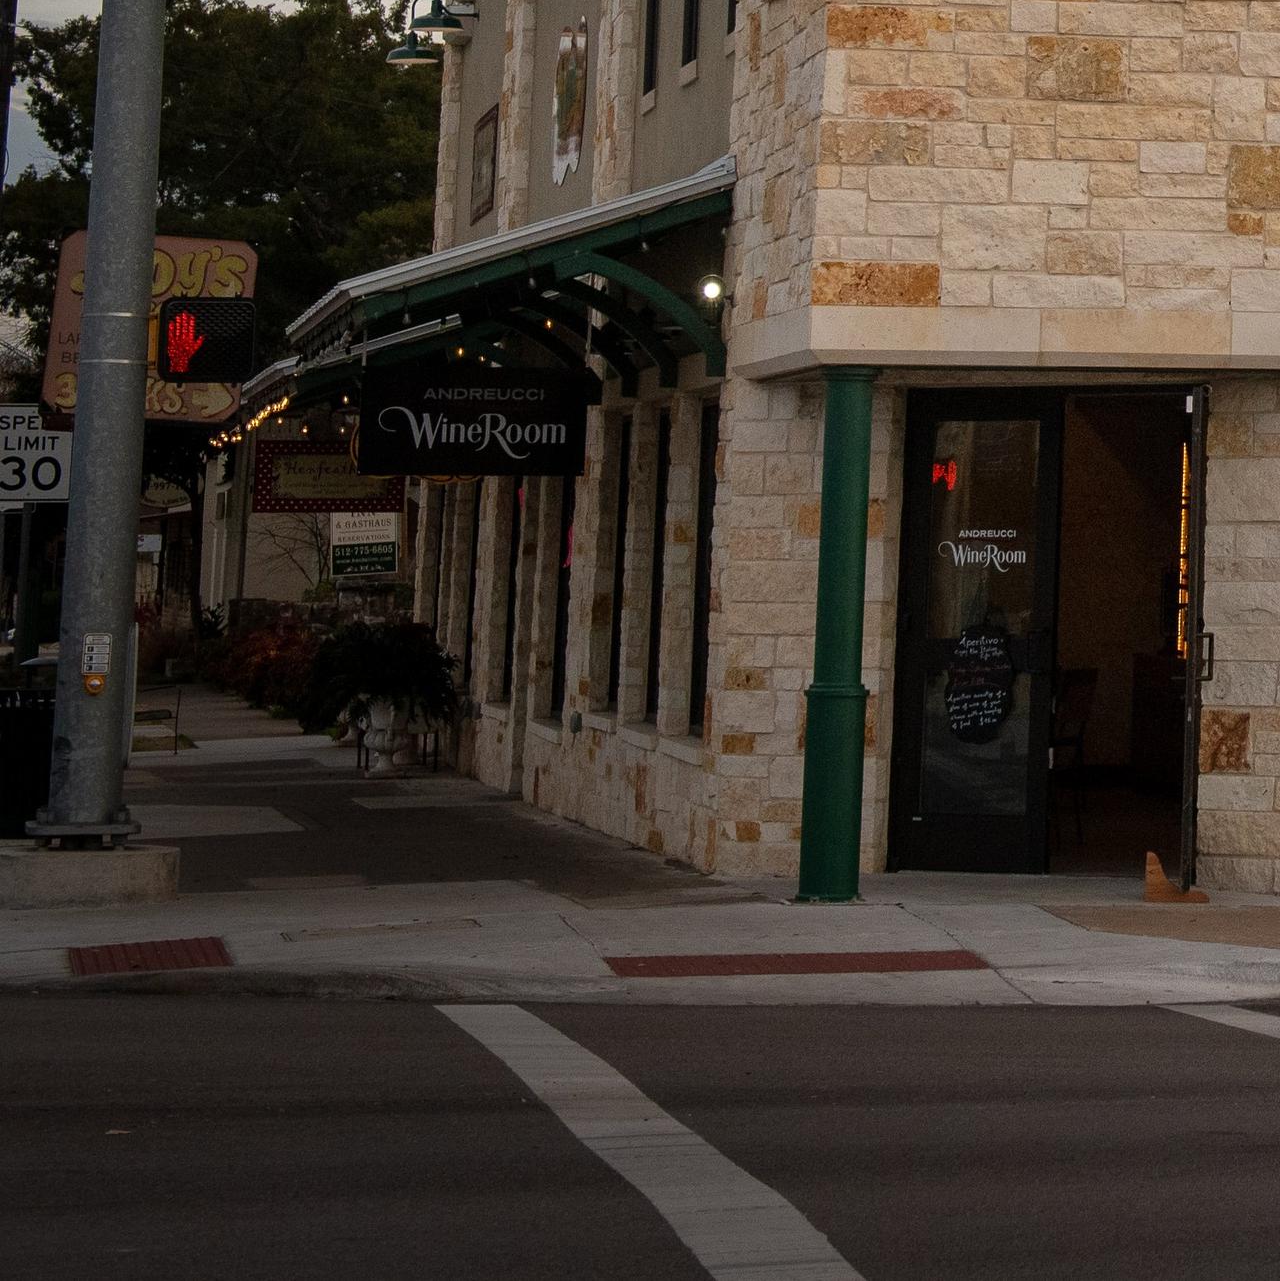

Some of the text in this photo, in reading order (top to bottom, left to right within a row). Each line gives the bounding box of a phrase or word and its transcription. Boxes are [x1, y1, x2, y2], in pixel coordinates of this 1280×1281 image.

[423, 387, 545, 401] ANDREUCCI
[4, 436, 60, 451] LIMIT
[0, 456, 62, 491] 30
[345, 518, 393, 529] GASTHAUS
[958, 529, 1017, 539] ANDREUCCI
